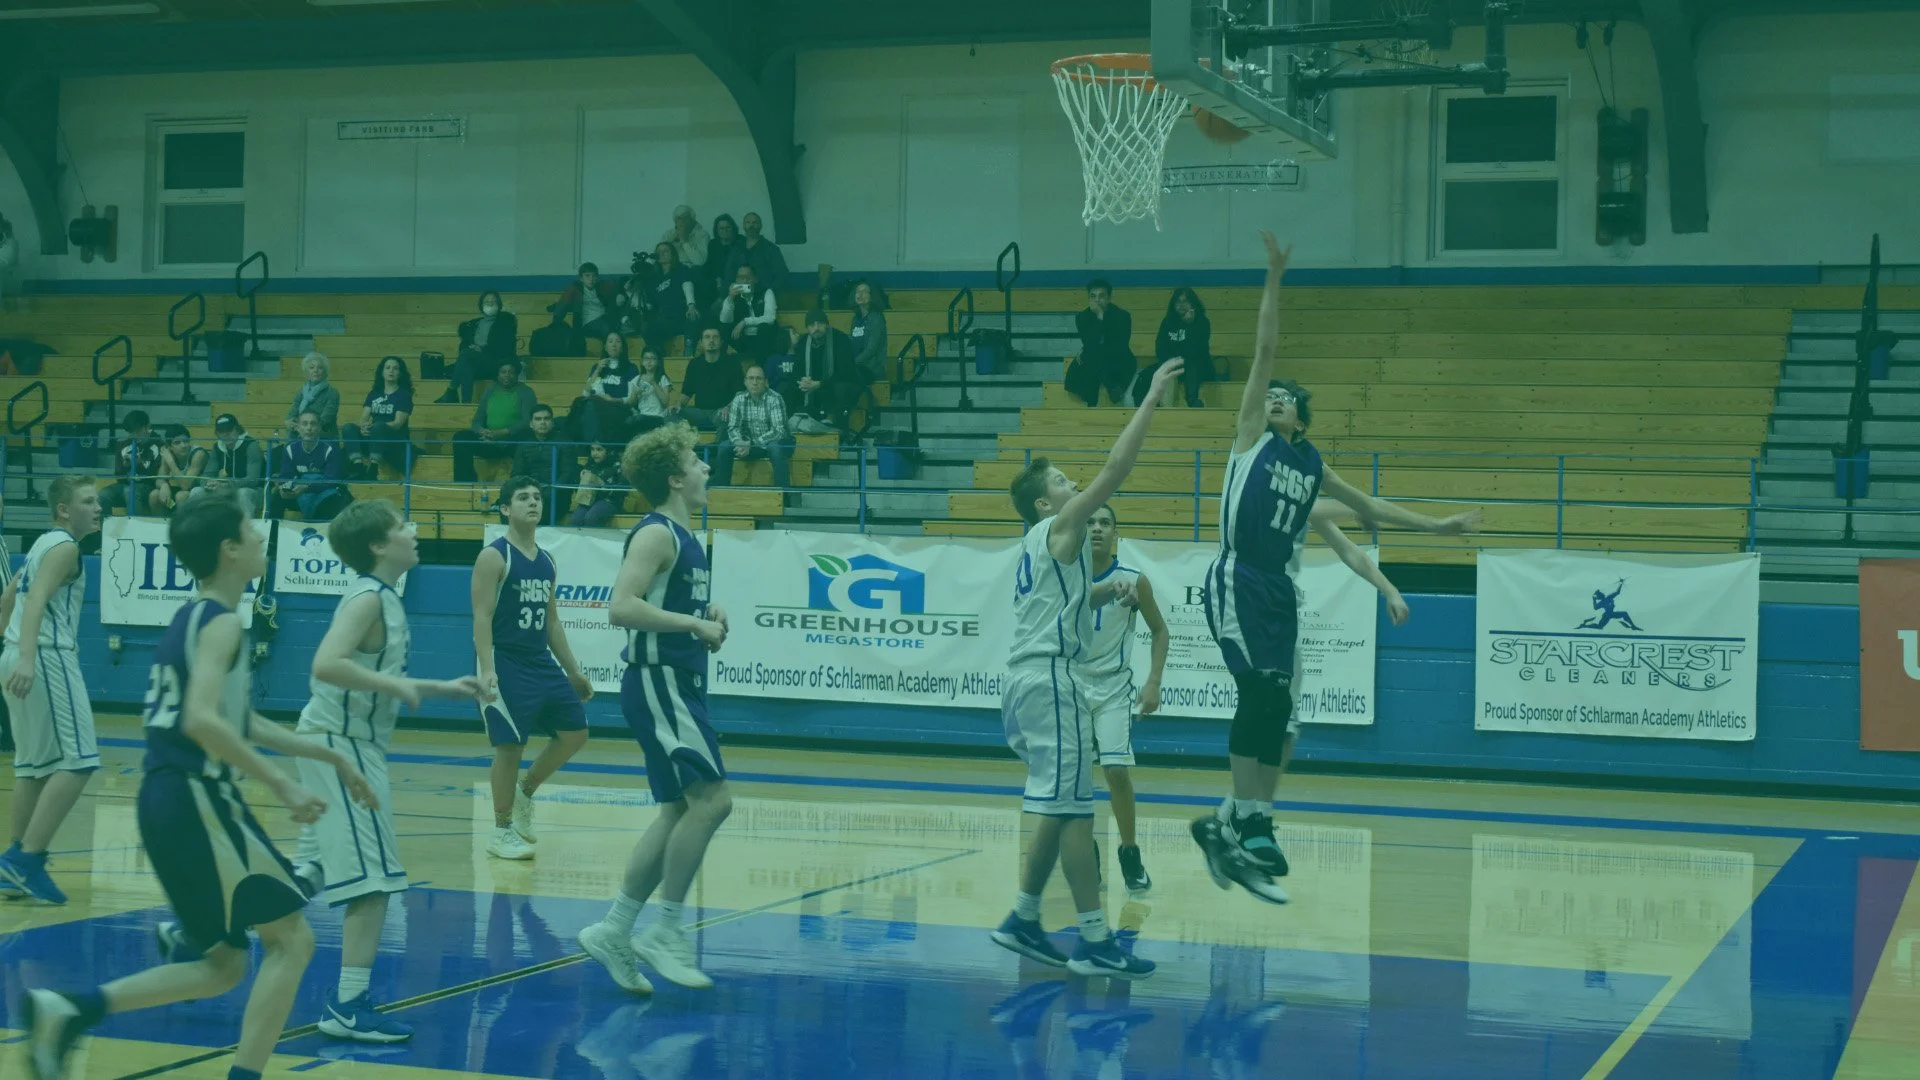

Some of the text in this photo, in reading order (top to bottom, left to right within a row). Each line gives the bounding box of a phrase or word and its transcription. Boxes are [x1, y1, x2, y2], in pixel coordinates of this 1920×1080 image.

[1269, 460, 1316, 505] NGS
[290, 557, 348, 575] TOPP
[284, 575, 348, 587] Schlarman
[520, 578, 552, 603] NGS
[555, 584, 613, 602] RMI
[162, 593, 198, 602] Elementar
[518, 606, 546, 631] 33
[754, 611, 980, 637] GREENHOUSE
[805, 633, 925, 649] MEGASTORE
[1301, 637, 1365, 649] lkire Chapel
[1489, 637, 1746, 671] STARCREST
[580, 660, 611, 683] larman
[716, 660, 752, 684] Proud
[756, 662, 806, 691] Sponsor
[809, 665, 824, 687] of
[826, 665, 894, 692] Schlarman
[897, 669, 958, 700] Academy
[1518, 666, 1716, 688] CLEANERS
[1160, 685, 1196, 712] ponsor
[1198, 682, 1210, 707] of
[1211, 682, 1240, 709] Schla
[1319, 687, 1366, 714] Athletics
[1484, 701, 1746, 731] Proud Sponsor of Schlarman Academy Athletics
